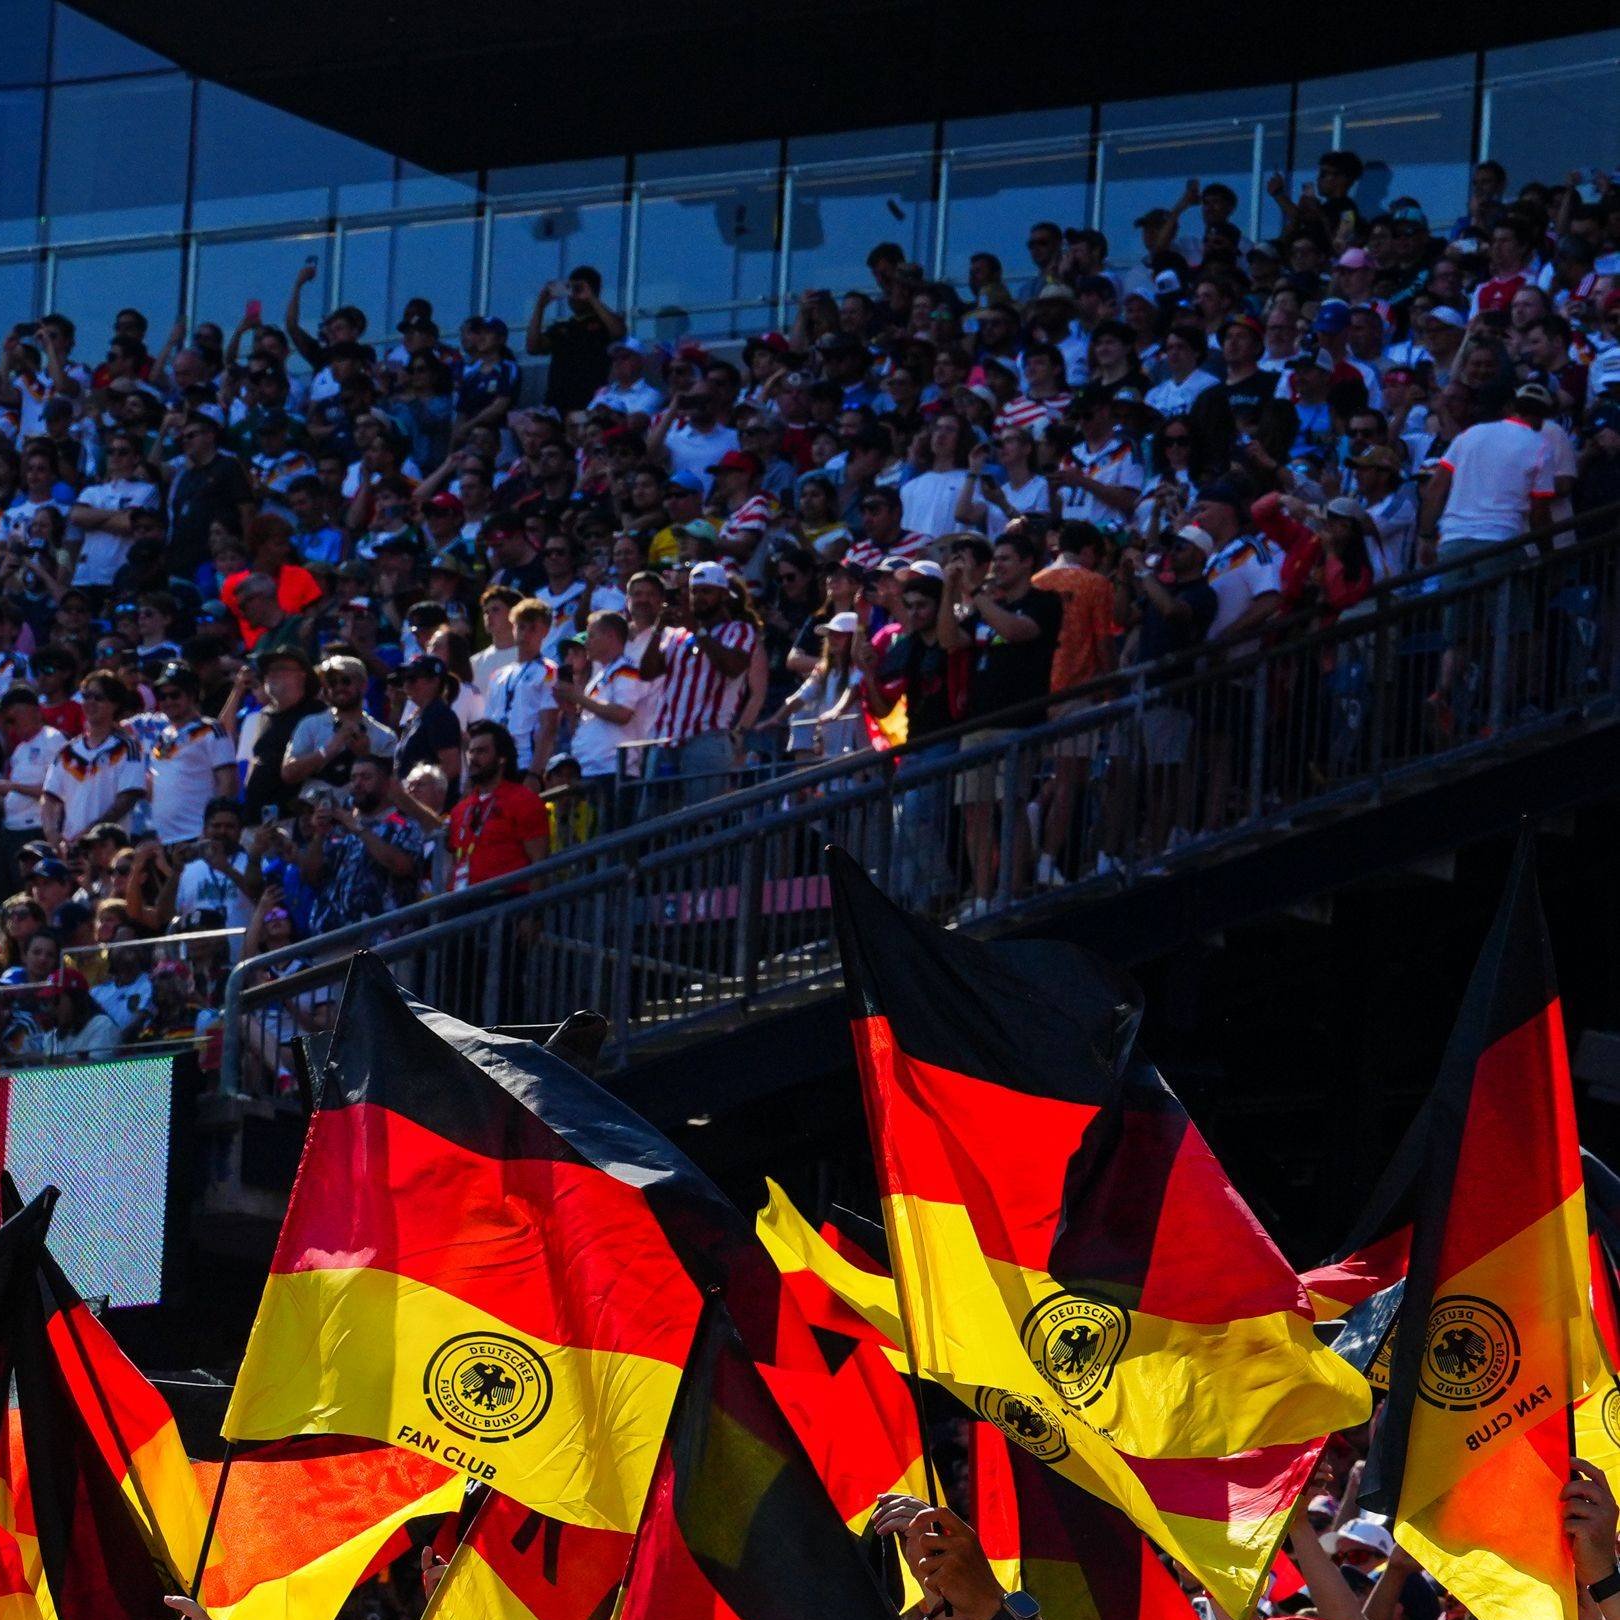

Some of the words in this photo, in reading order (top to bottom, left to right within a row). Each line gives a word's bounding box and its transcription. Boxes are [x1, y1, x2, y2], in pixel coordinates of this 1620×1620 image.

[1049, 1305, 1116, 1332] DEUTSCHER
[469, 1345, 535, 1383] DEUTSCHER
[440, 1379, 520, 1428] FUSSBALL-BUND
[396, 1425, 441, 1454] FAN
[442, 1446, 498, 1481] CLUB
